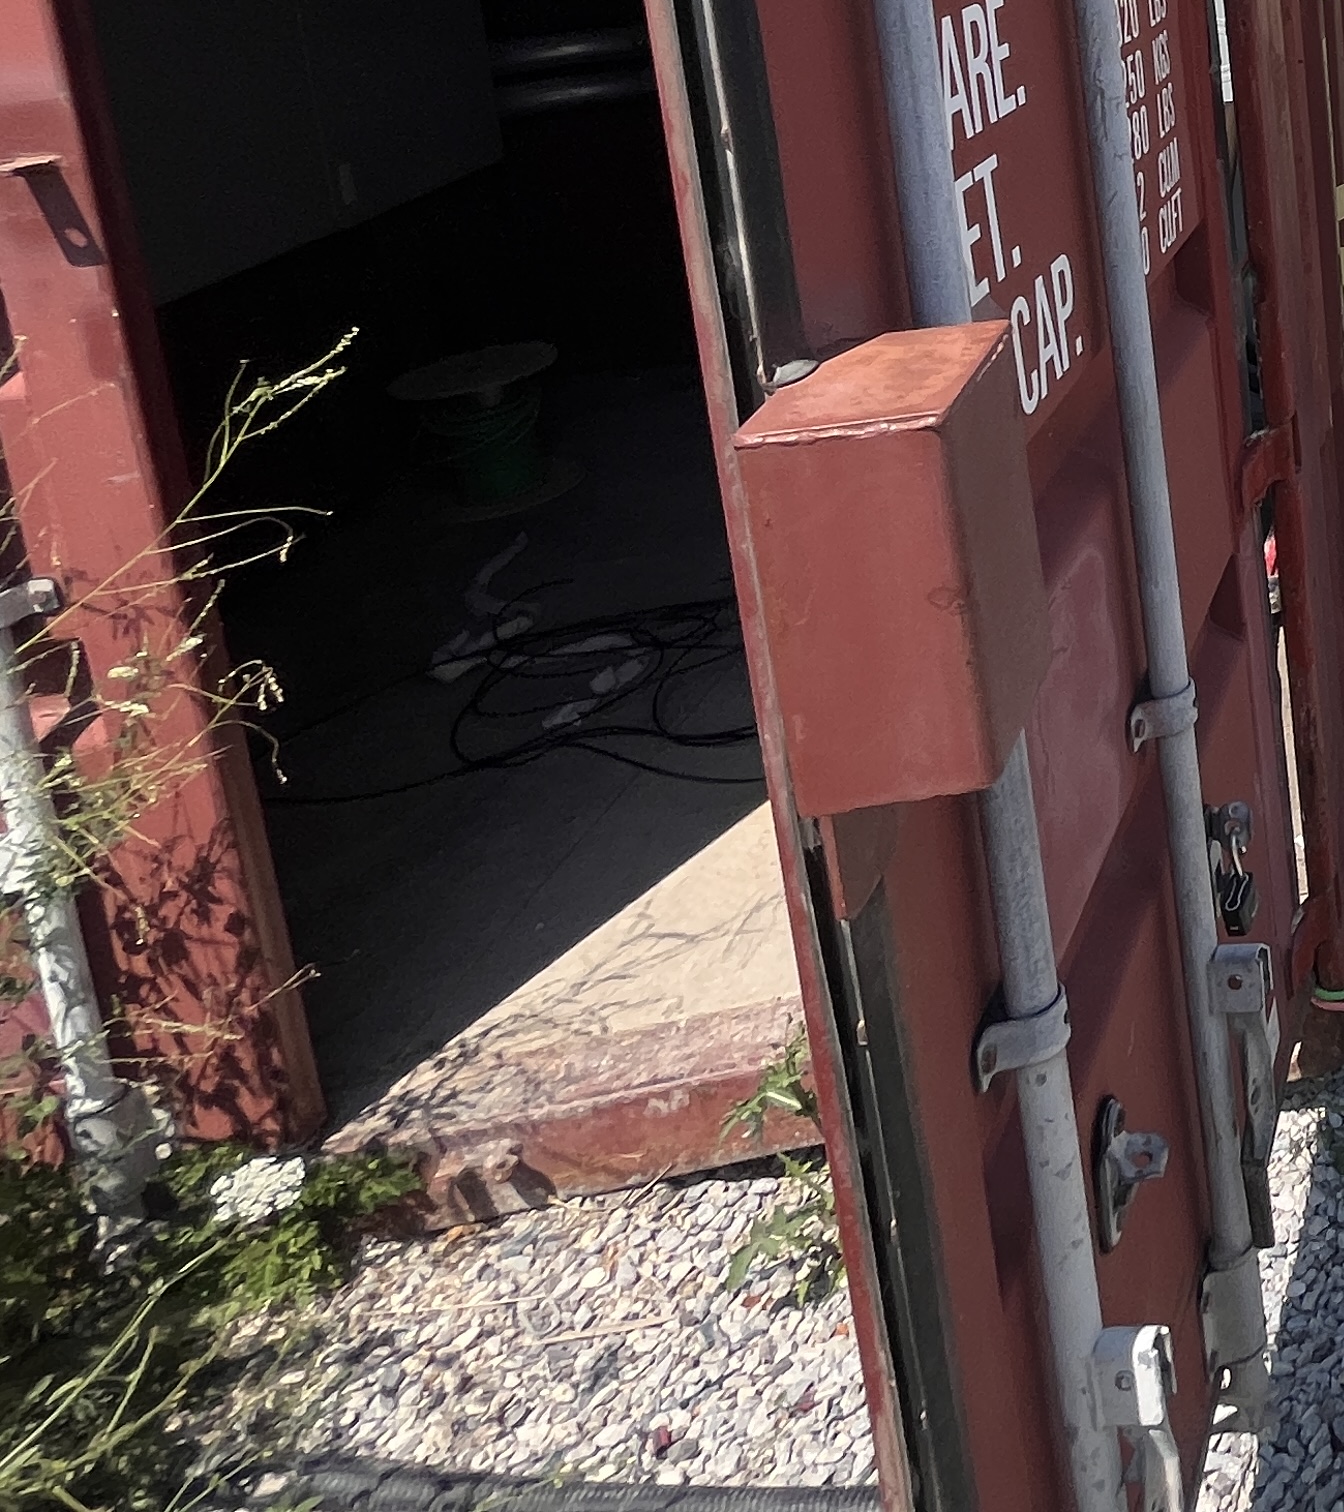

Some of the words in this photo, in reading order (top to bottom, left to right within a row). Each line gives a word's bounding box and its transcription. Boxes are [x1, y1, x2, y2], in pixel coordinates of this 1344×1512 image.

[1124, 49, 1146, 106] 50
[1152, 29, 1172, 86] KGS
[1131, 104, 1150, 161] 80
[1156, 81, 1176, 139] LBS
[954, 153, 1022, 308] ET.
[1136, 170, 1148, 222] 2
[1140, 225, 1150, 276] 0
[1009, 253, 1084, 417] CAP.
